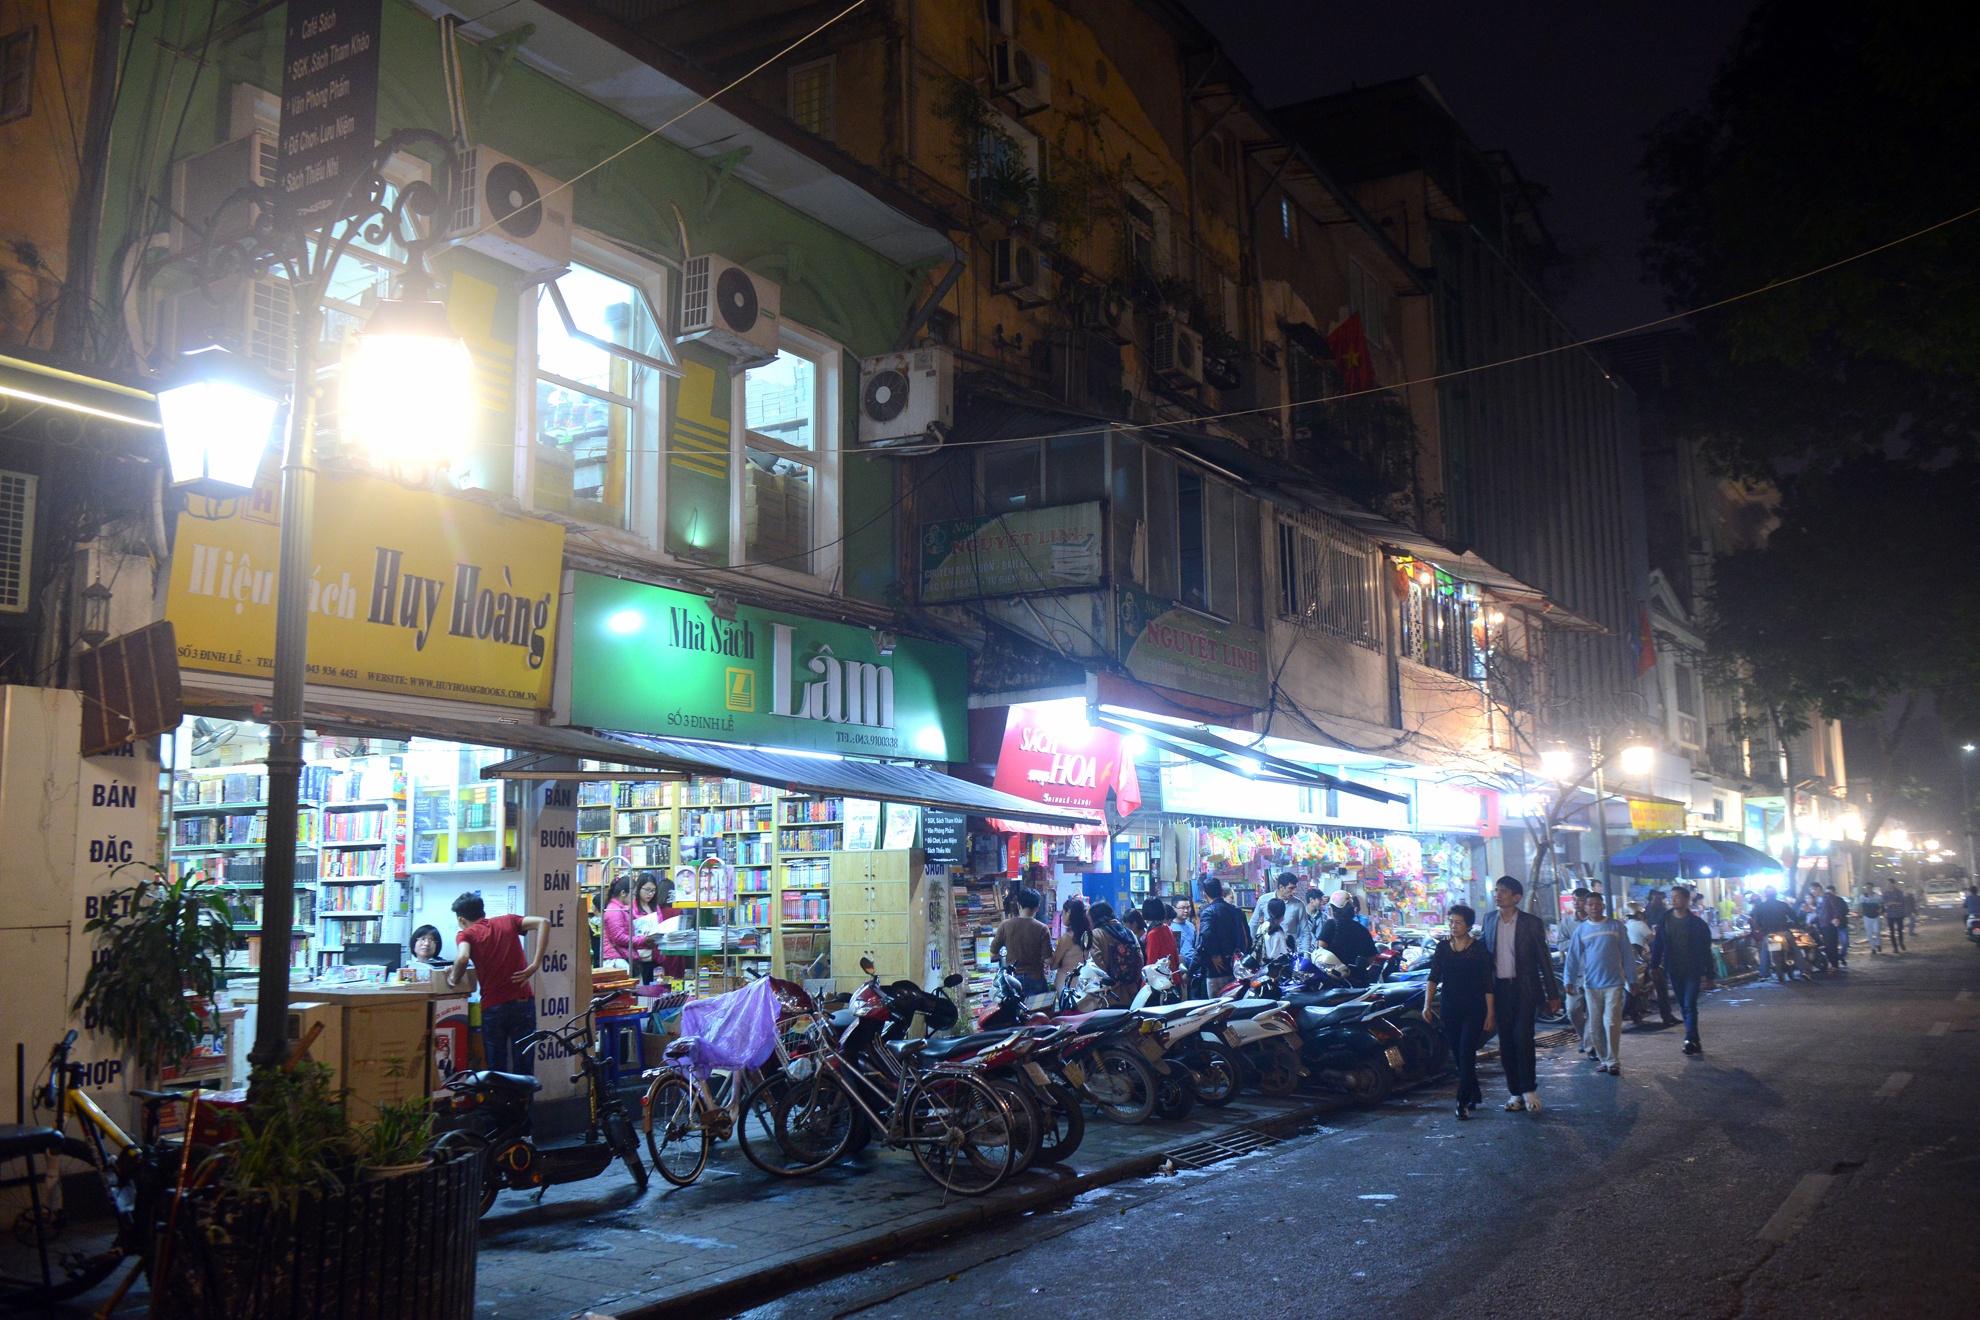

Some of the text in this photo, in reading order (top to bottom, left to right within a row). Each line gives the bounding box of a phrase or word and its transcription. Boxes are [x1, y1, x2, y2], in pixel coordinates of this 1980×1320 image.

[319, 9, 337, 32] Sách
[331, 41, 350, 63] Tham
[326, 156, 339, 179] Nhi
[951, 530, 1033, 554] NGUYỆT
[187, 544, 551, 670] Hiệu ách Huy Hoàng
[669, 606, 754, 659] Nhà Sách
[1146, 620, 1217, 665] NGUYỆT
[1222, 643, 1259, 674] LINH
[192, 649, 198, 659] 3
[322, 665, 336, 677] 936
[339, 667, 358, 679] 4451
[368, 671, 408, 686] WEBSITE:
[769, 623, 895, 729] Lâm
[668, 708, 682, 726] SỐ
[683, 715, 689, 726] 3
[1049, 752, 1097, 789] HOA
[92, 779, 137, 808] BÁN
[545, 785, 571, 807] BÁN
[541, 827, 575, 848] BUÔN
[89, 835, 133, 868] ĐẶC
[544, 870, 570, 891] BÁN
[550, 903, 564, 928] LẺ
[542, 950, 568, 973] CÁC
[541, 997, 569, 1019] LOẠI
